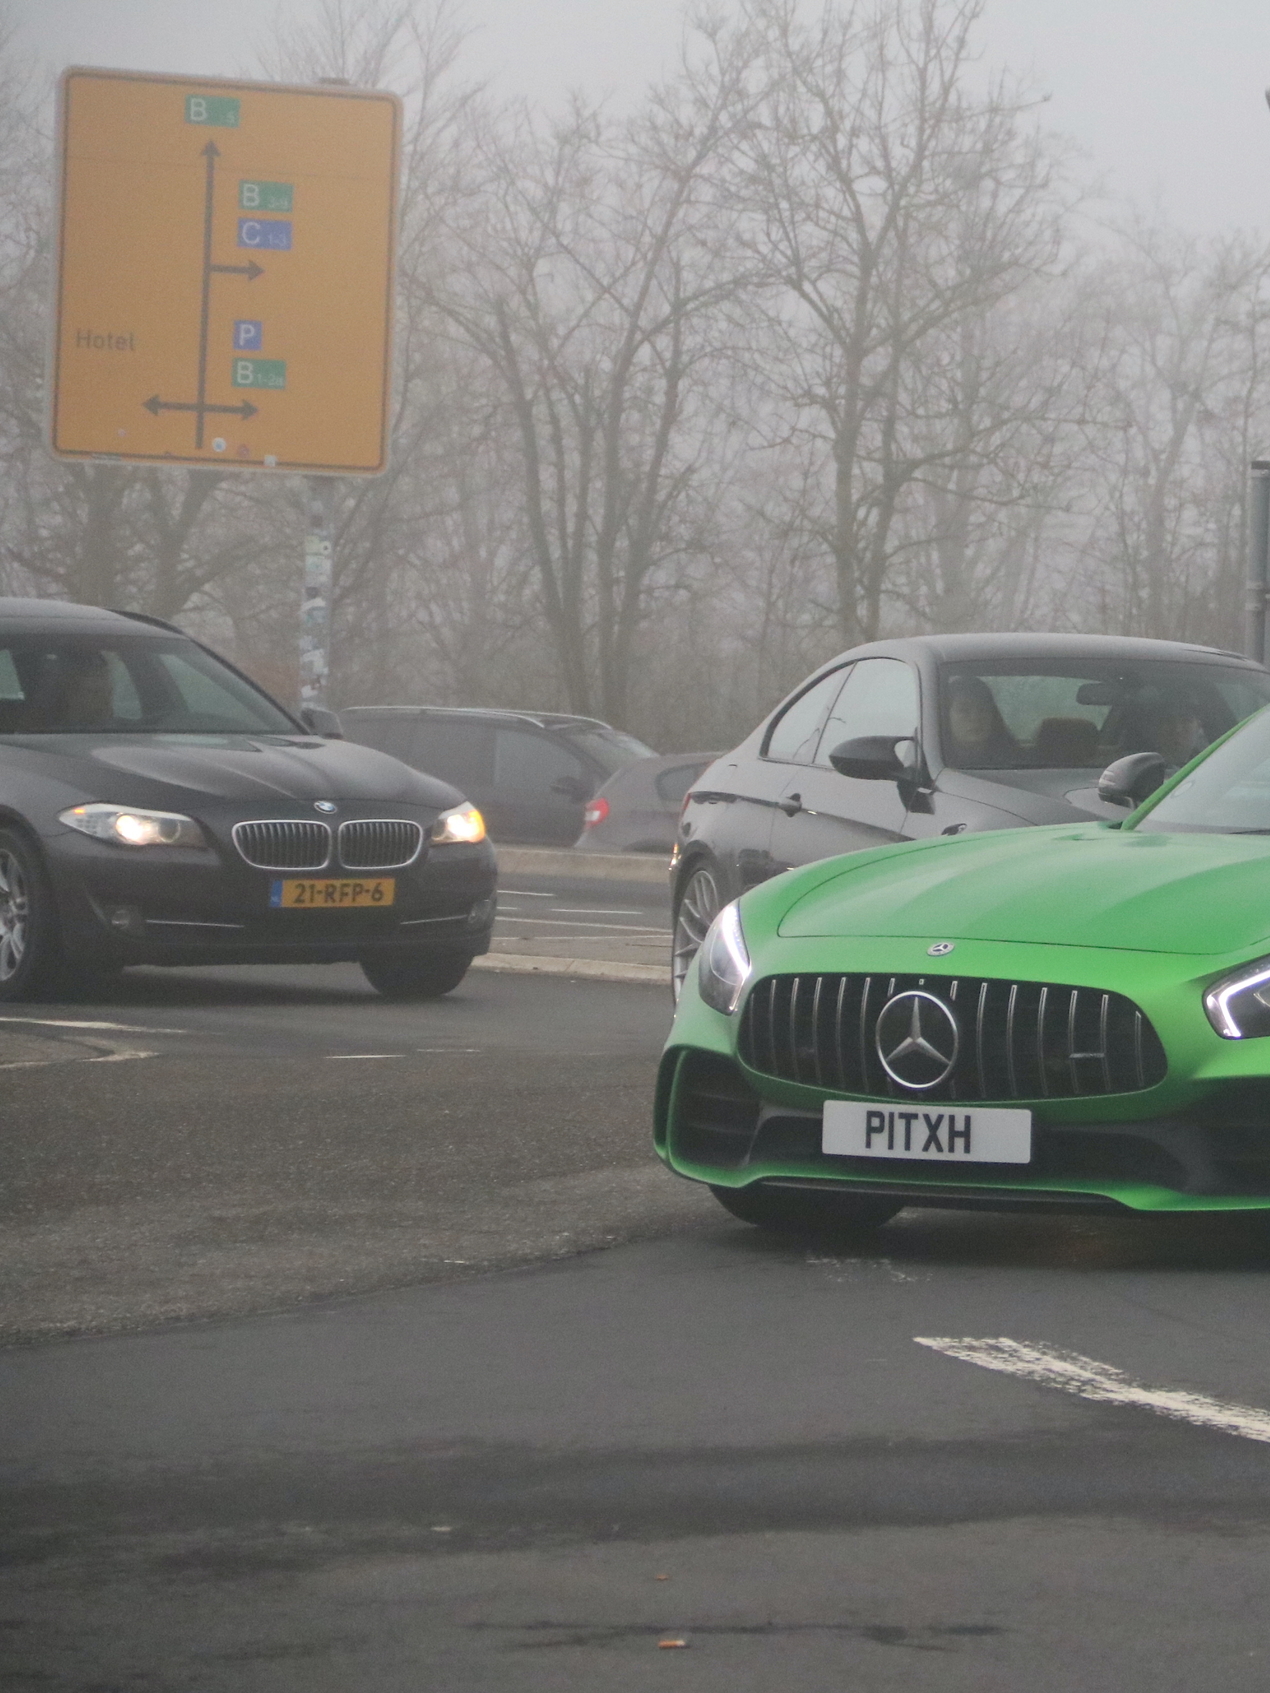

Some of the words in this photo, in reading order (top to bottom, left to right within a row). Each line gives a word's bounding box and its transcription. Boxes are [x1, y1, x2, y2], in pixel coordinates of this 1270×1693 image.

[190, 98, 208, 121] B
[243, 183, 260, 206] B
[242, 221, 260, 245] C
[76, 329, 135, 351] Hotel
[239, 323, 255, 347] P
[237, 360, 253, 384] B
[293, 882, 384, 904] 21-RFP-6
